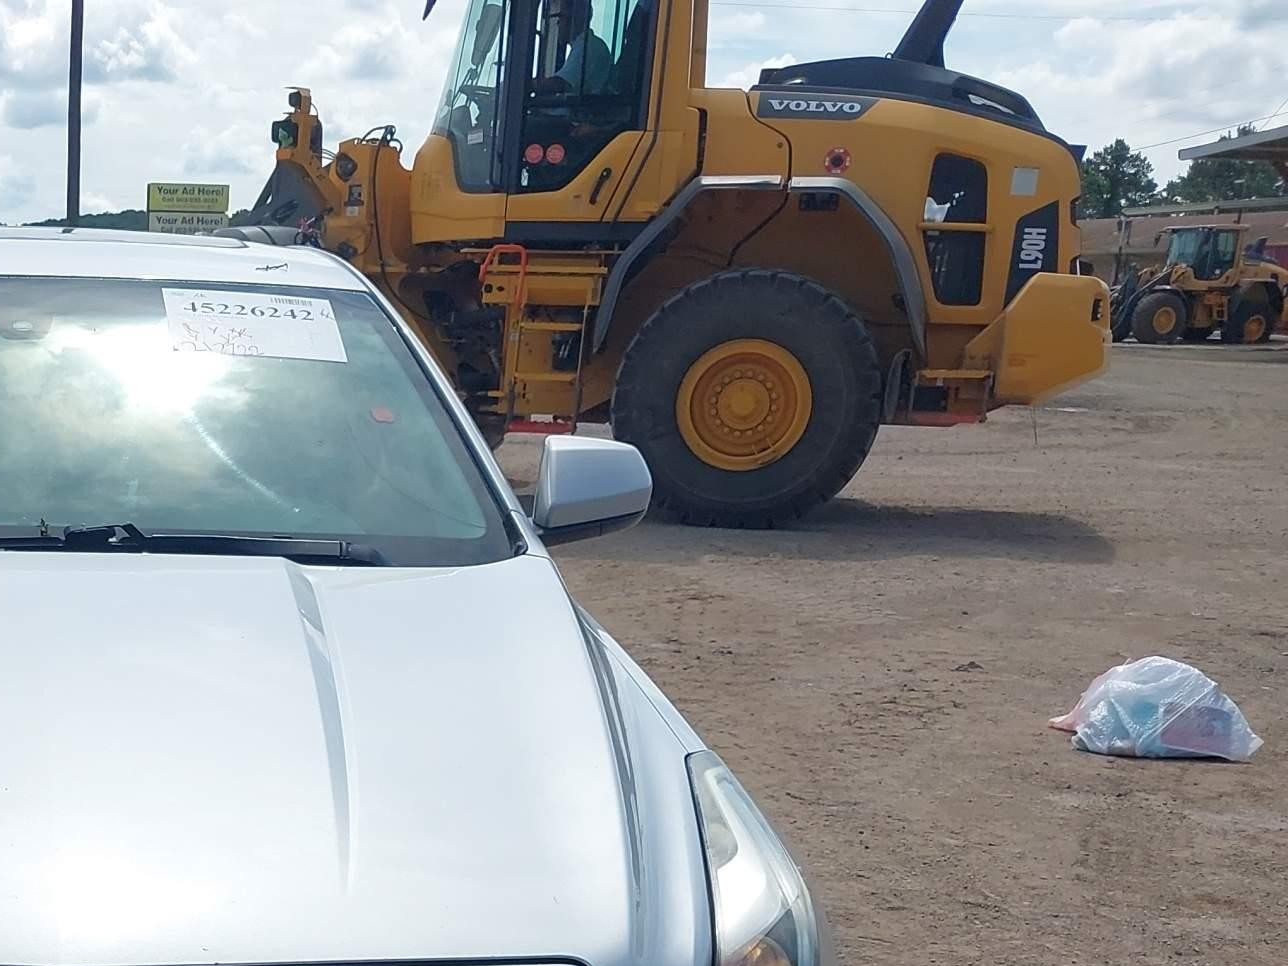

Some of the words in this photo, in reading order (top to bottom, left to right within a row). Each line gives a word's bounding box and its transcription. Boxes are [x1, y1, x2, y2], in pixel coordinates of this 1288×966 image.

[768, 99, 861, 113] VOLVO
[157, 186, 179, 196] Your
[181, 186, 195, 196] Ad
[198, 187, 224, 197] Here!
[155, 215, 178, 225] Your
[181, 216, 194, 225] Ad
[197, 216, 223, 226] Here!
[1018, 227, 1047, 269] L90H
[183, 301, 315, 321] 45226242
